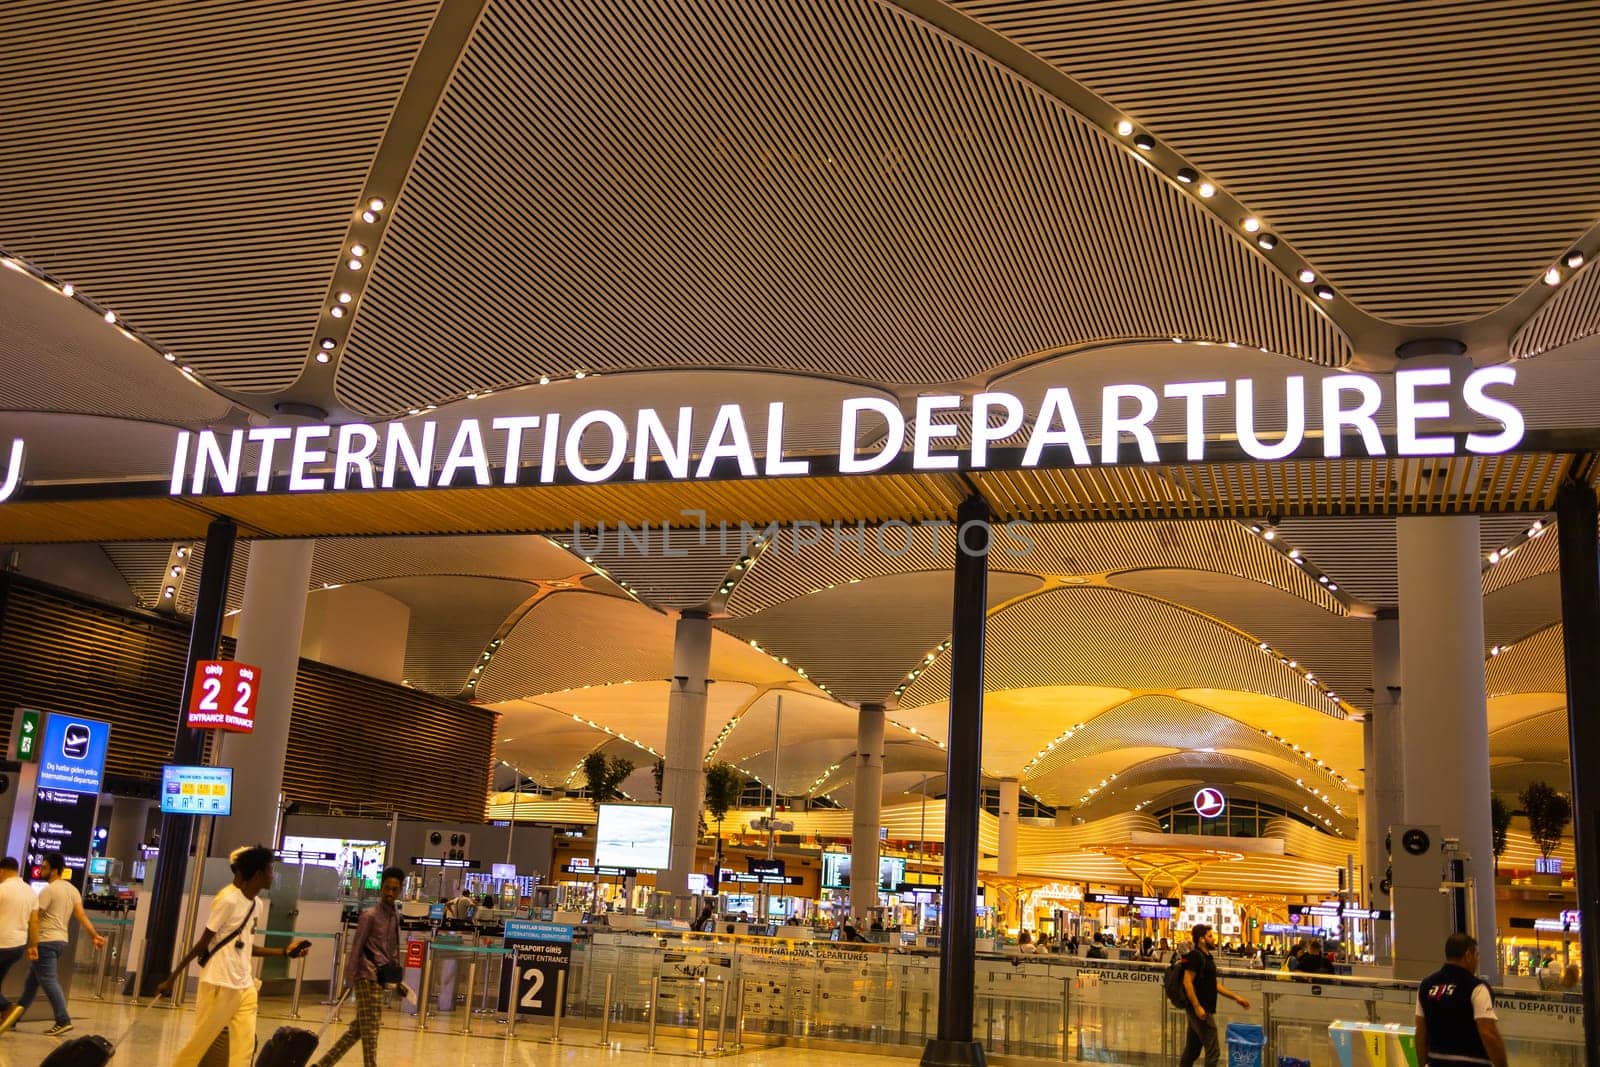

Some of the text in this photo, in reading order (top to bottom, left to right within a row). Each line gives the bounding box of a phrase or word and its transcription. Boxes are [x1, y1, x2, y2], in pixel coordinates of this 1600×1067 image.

[169, 366, 1526, 496] INTERNATIONAL DEPARTURES
[199, 677, 221, 710] 2
[233, 681, 252, 715] 2
[189, 713, 225, 723] ENTRANCE
[225, 714, 254, 728] ENTRANCE
[536, 955, 569, 964] ENTRANCE
[816, 950, 869, 962] DEPARTURES
[1130, 973, 1159, 983] GİDEN
[520, 968, 545, 1009] 2
